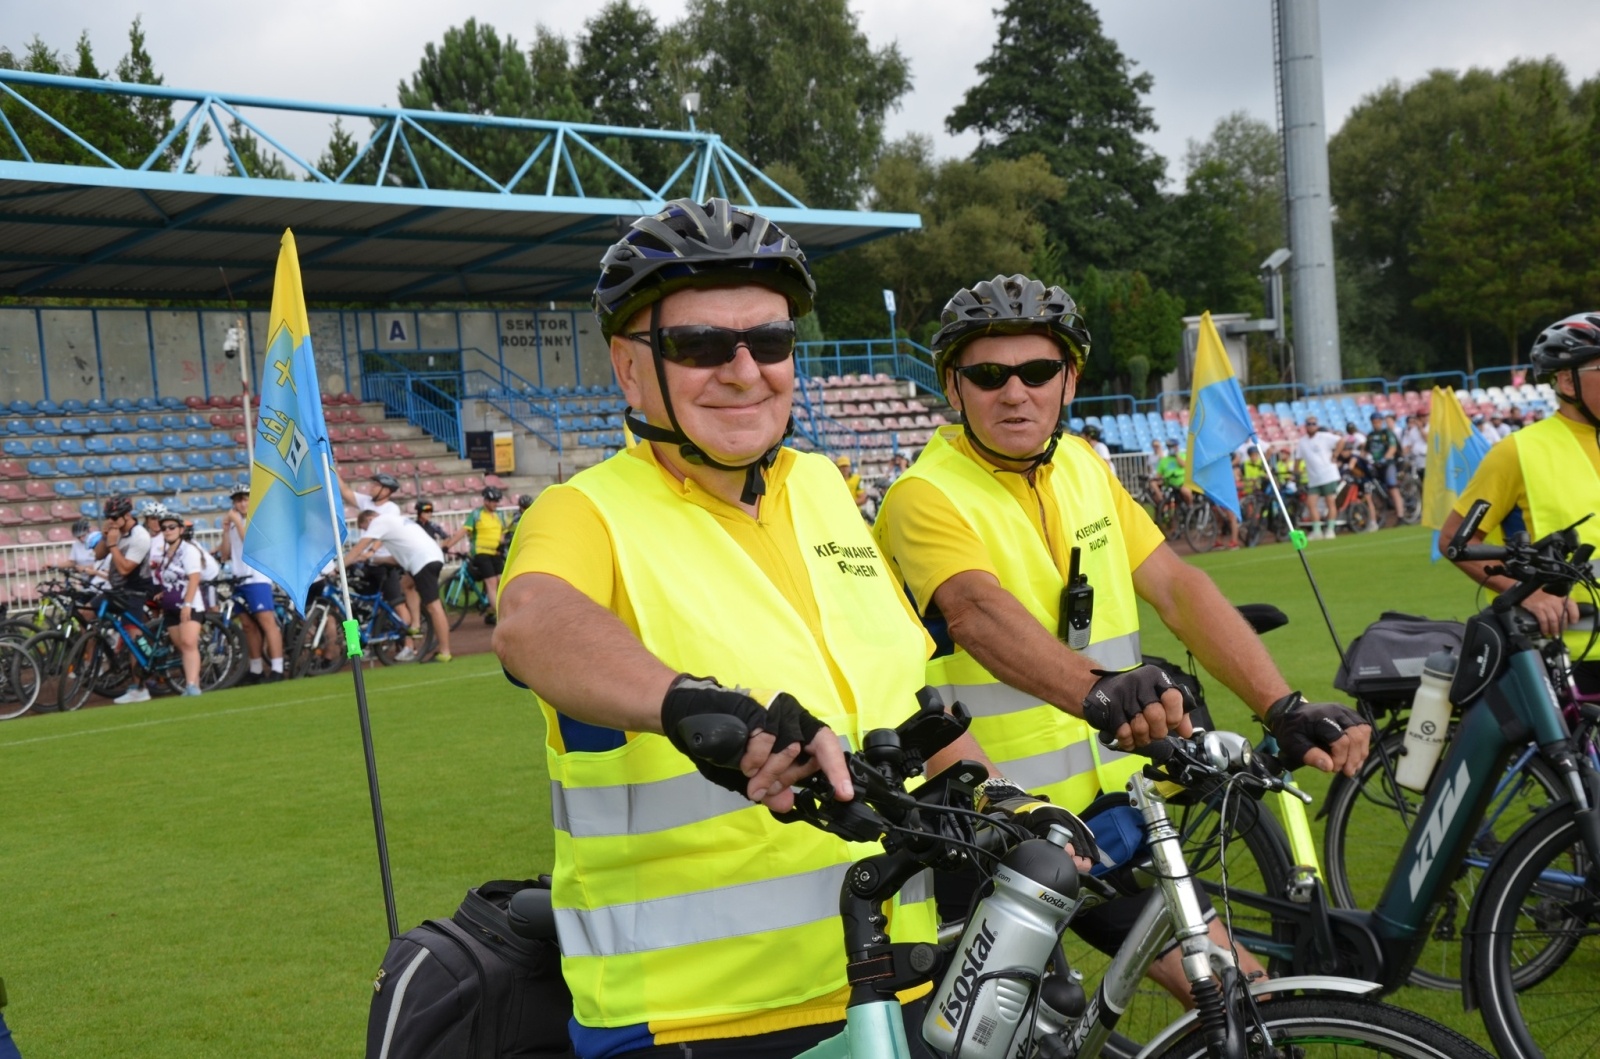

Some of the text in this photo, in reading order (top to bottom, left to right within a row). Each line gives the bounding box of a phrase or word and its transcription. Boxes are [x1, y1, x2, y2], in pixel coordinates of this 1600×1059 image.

[389, 319, 407, 342] A
[505, 318, 569, 331] SEKTOR
[836, 560, 878, 577] RCHEM
[939, 918, 997, 1029] isostar
